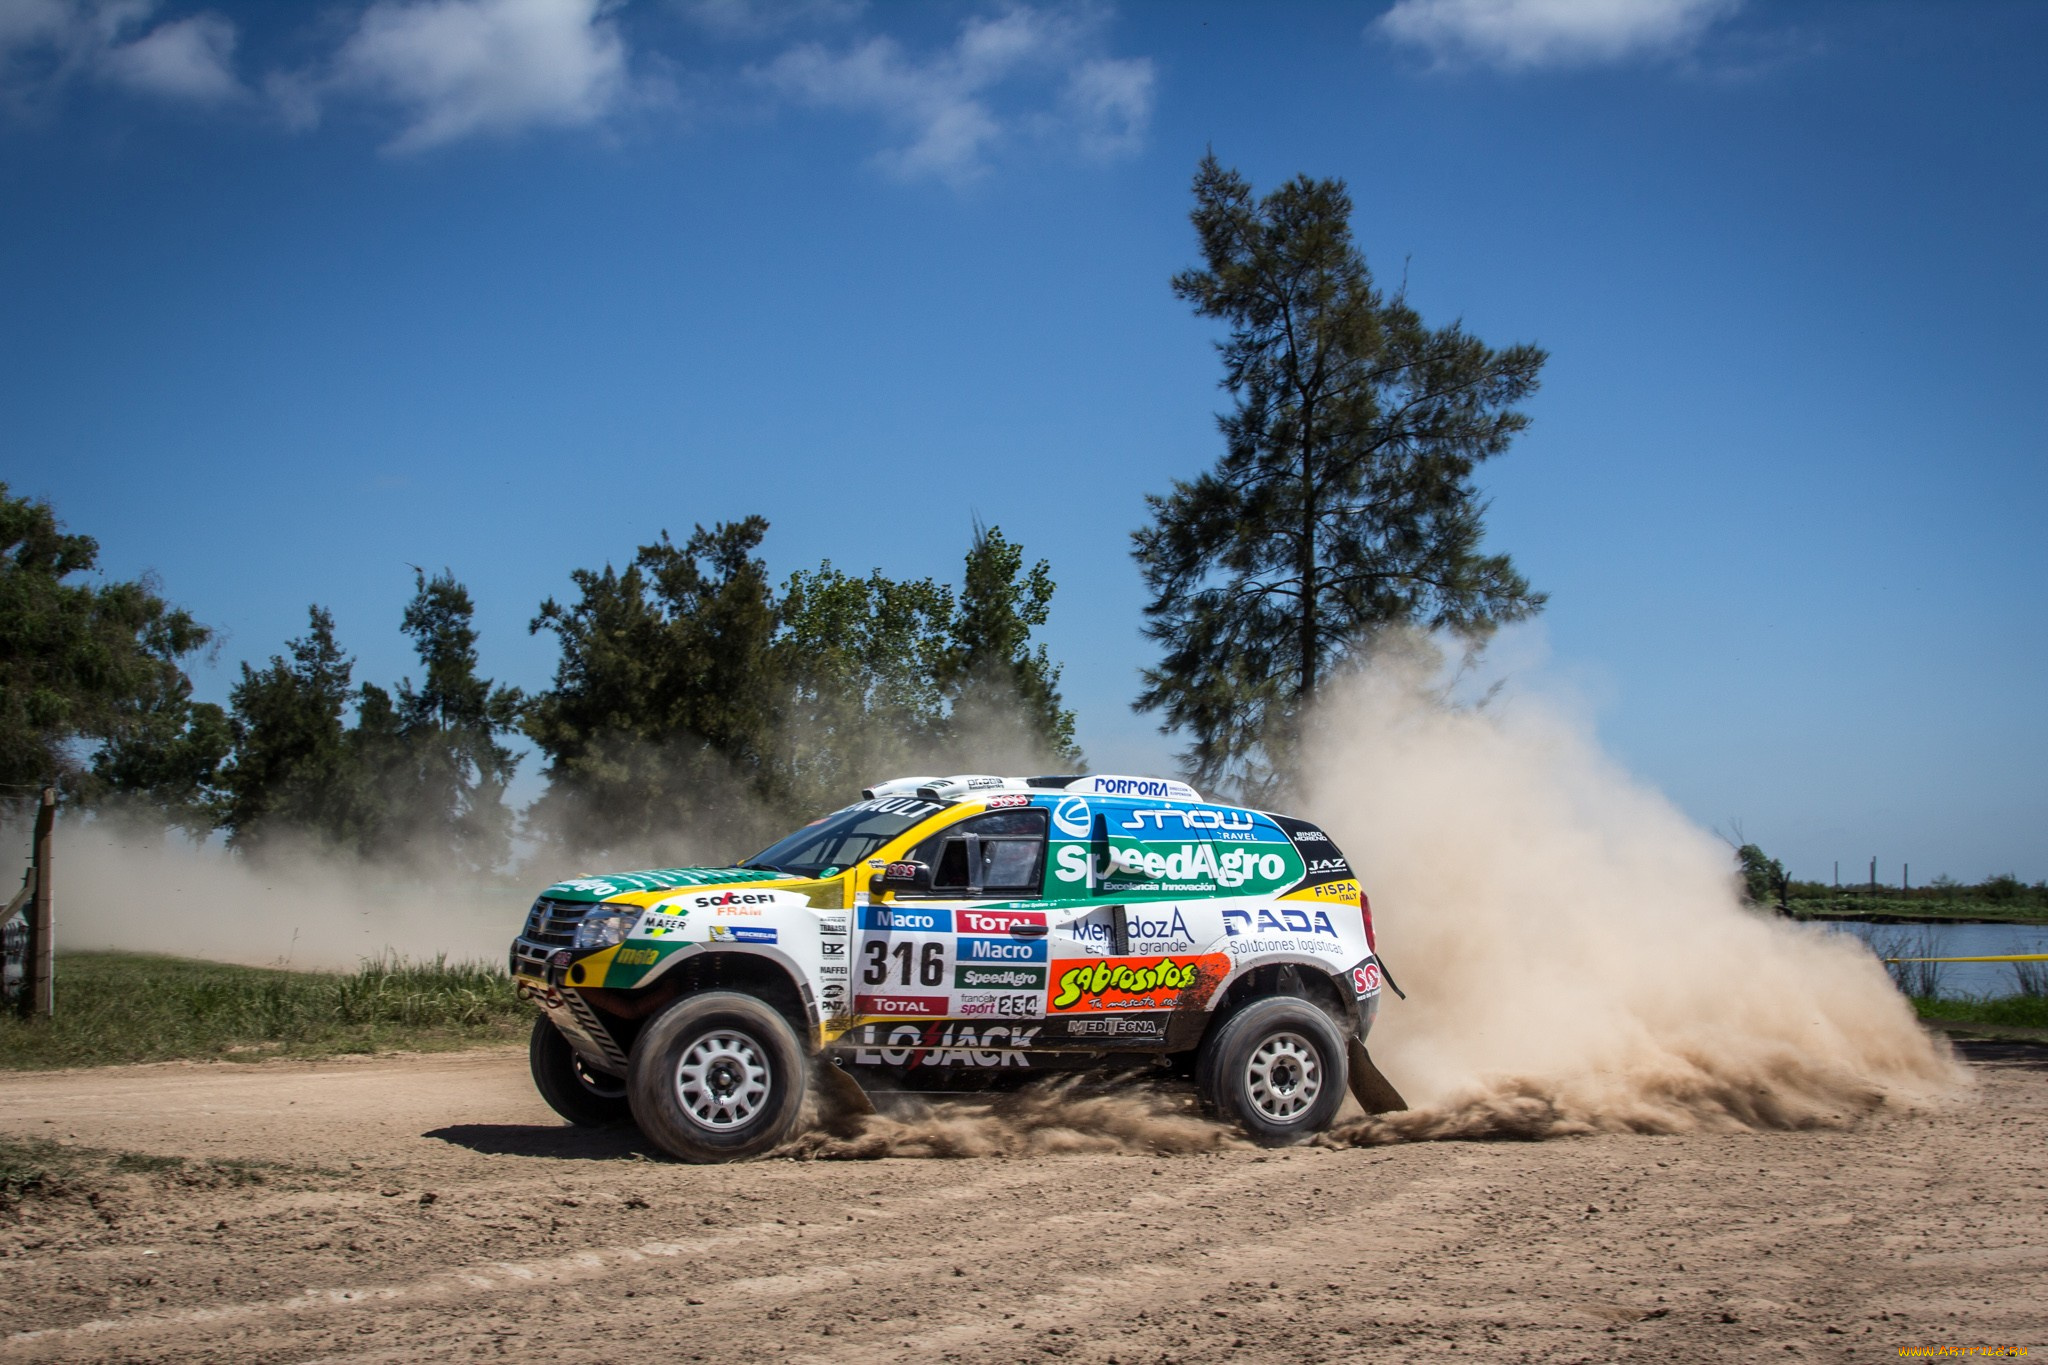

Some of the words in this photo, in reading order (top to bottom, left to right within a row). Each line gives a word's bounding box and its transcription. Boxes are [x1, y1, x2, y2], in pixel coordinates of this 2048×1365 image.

[1054, 844, 1286, 889] SpeedAgro
[1309, 859, 1346, 871] JAZ
[1102, 881, 1160, 891] Excelencia
[1162, 881, 1216, 891] Innovación
[1314, 882, 1356, 897] FISPA
[1339, 893, 1357, 901] ITALY
[644, 917, 687, 930] MAFER
[877, 910, 934, 928] Macro
[1221, 909, 1338, 938] DADA
[972, 941, 1033, 959] Macro
[1140, 939, 1187, 955] grande
[1230, 938, 1295, 954] Soluciones
[863, 940, 945, 987] 316
[963, 971, 1037, 986] SpeedAgro
[873, 998, 930, 1012] TOTAL
[960, 1003, 995, 1015] sport
[1089, 999, 1102, 1008] Tu
[1106, 998, 1155, 1008] mascota
